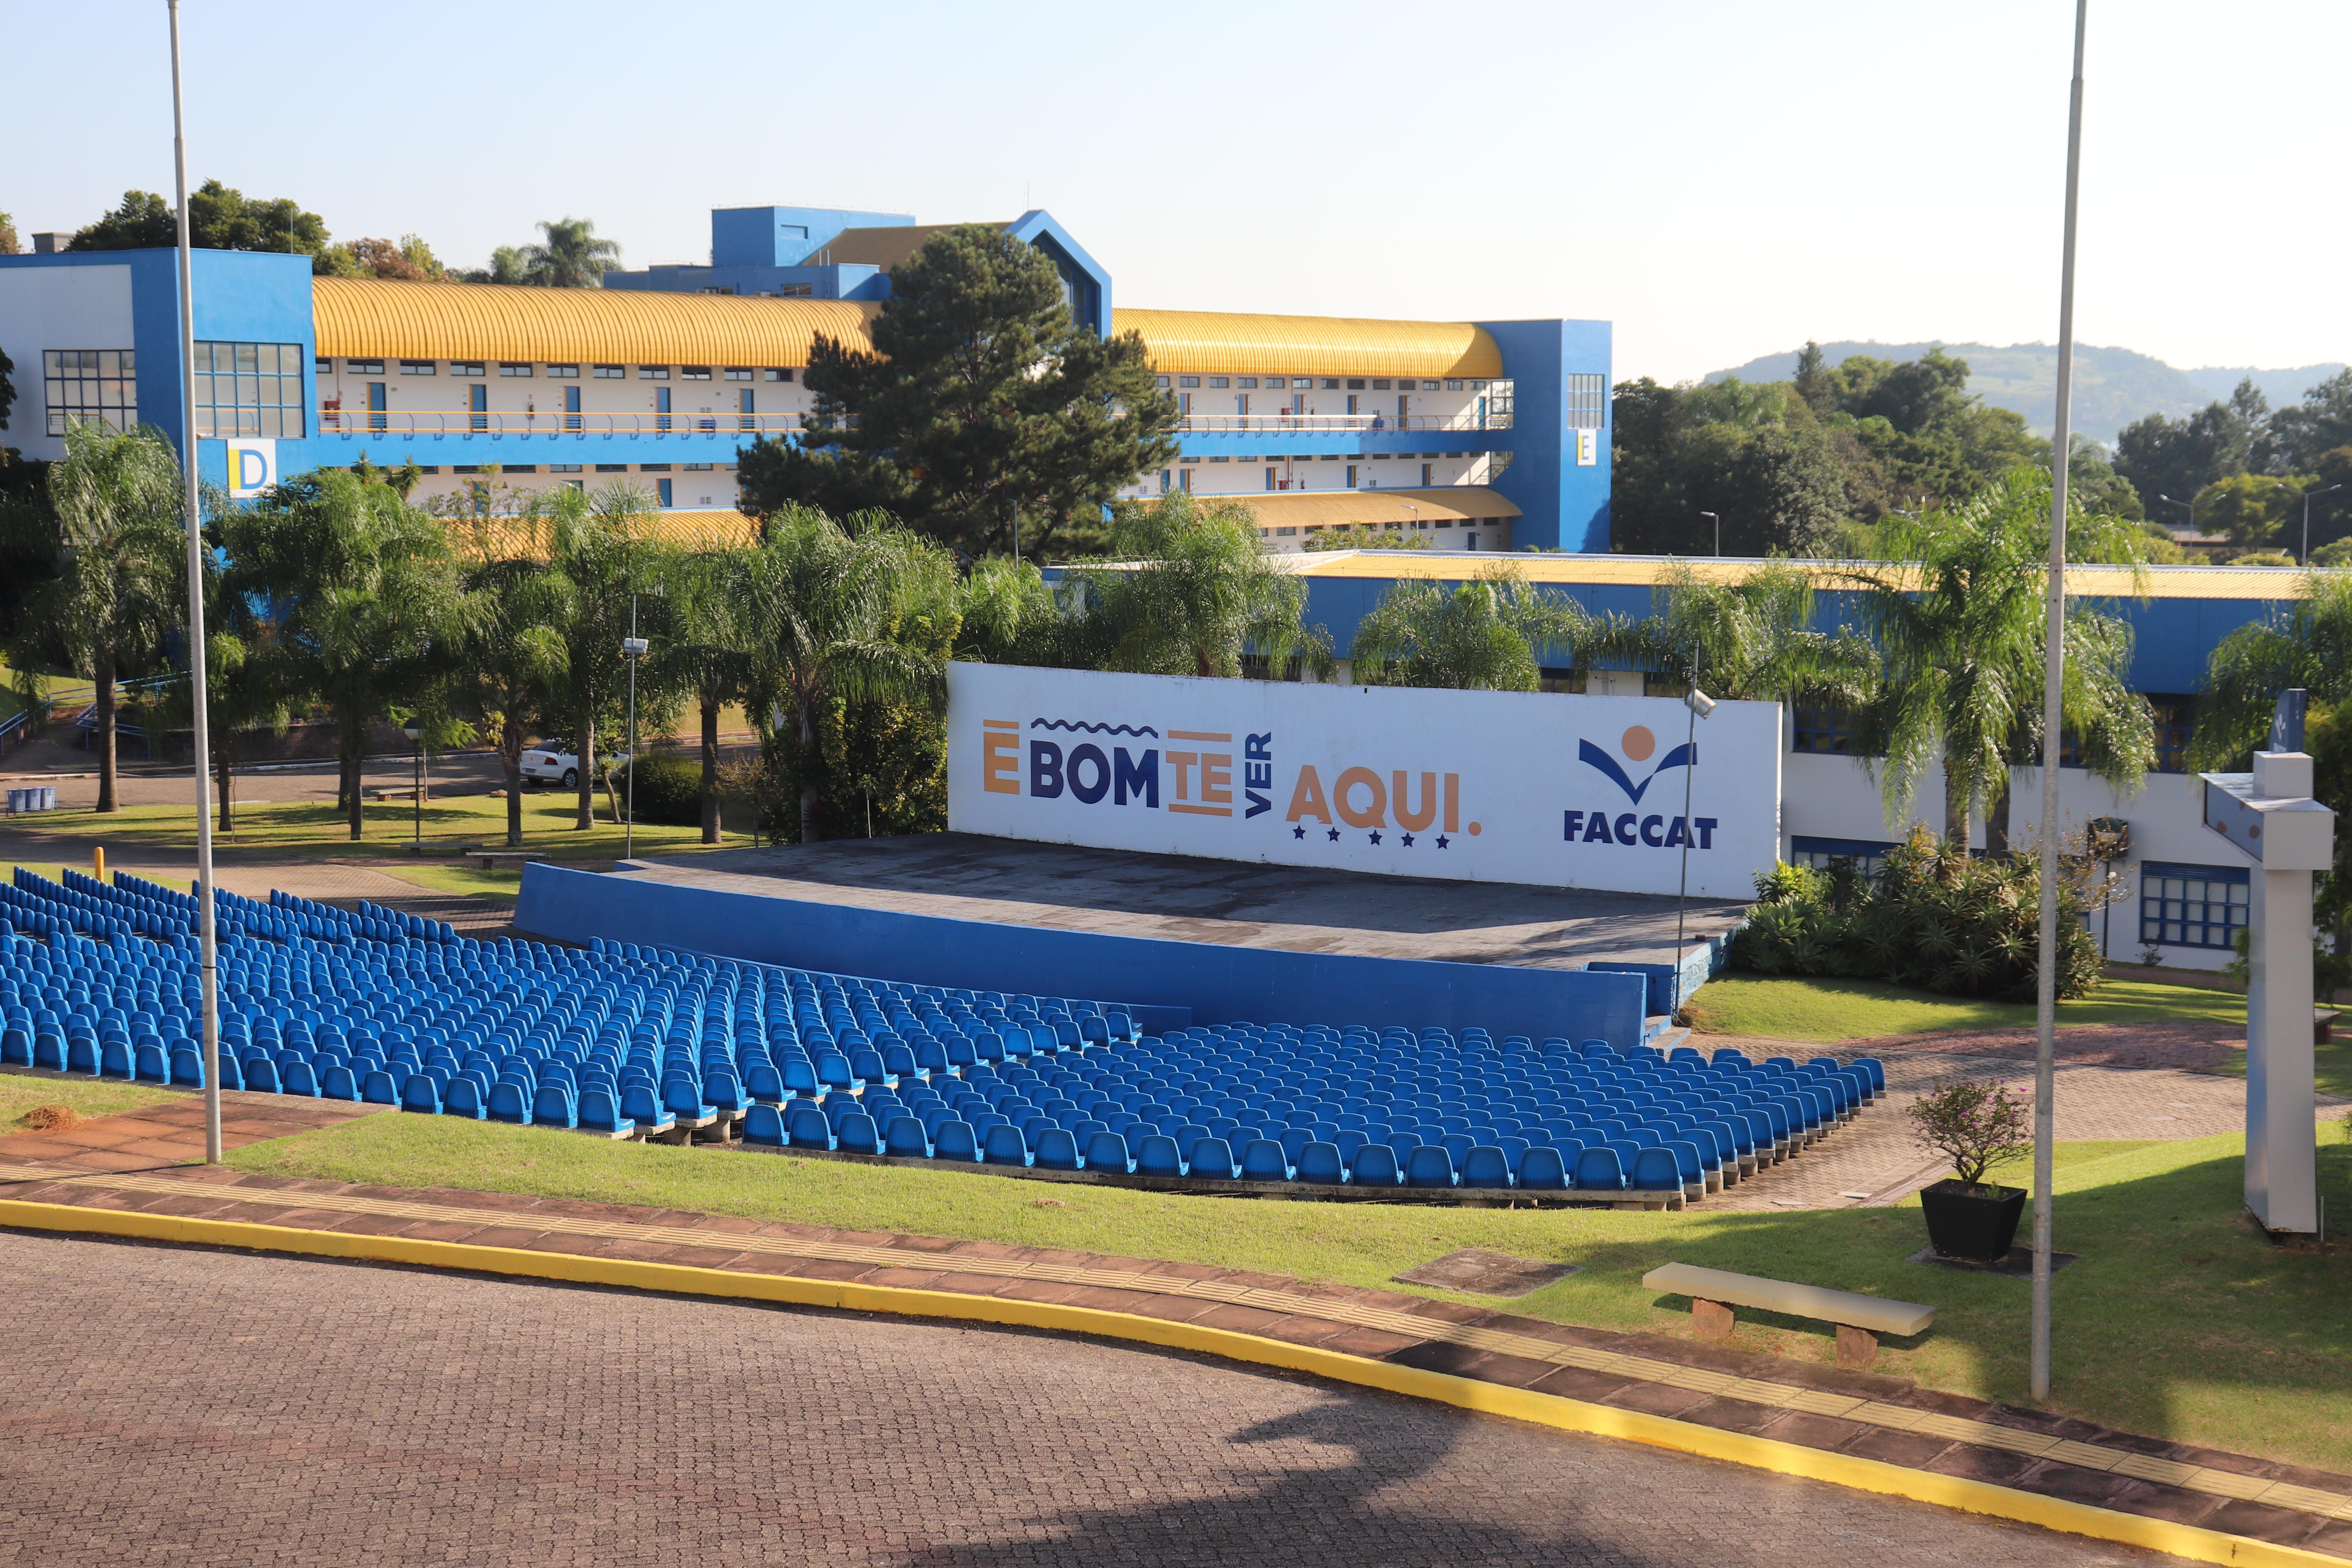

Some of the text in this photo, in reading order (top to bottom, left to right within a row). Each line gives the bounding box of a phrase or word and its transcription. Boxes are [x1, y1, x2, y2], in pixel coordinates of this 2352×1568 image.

[1581, 435, 1589, 460] E
[239, 449, 268, 490] D
[1030, 740, 1159, 809] BOM
[1165, 750, 1232, 804] TE
[1245, 731, 1272, 819] VER
[1286, 764, 1482, 836] AQUI.
[1564, 809, 1718, 850] FACCAT
